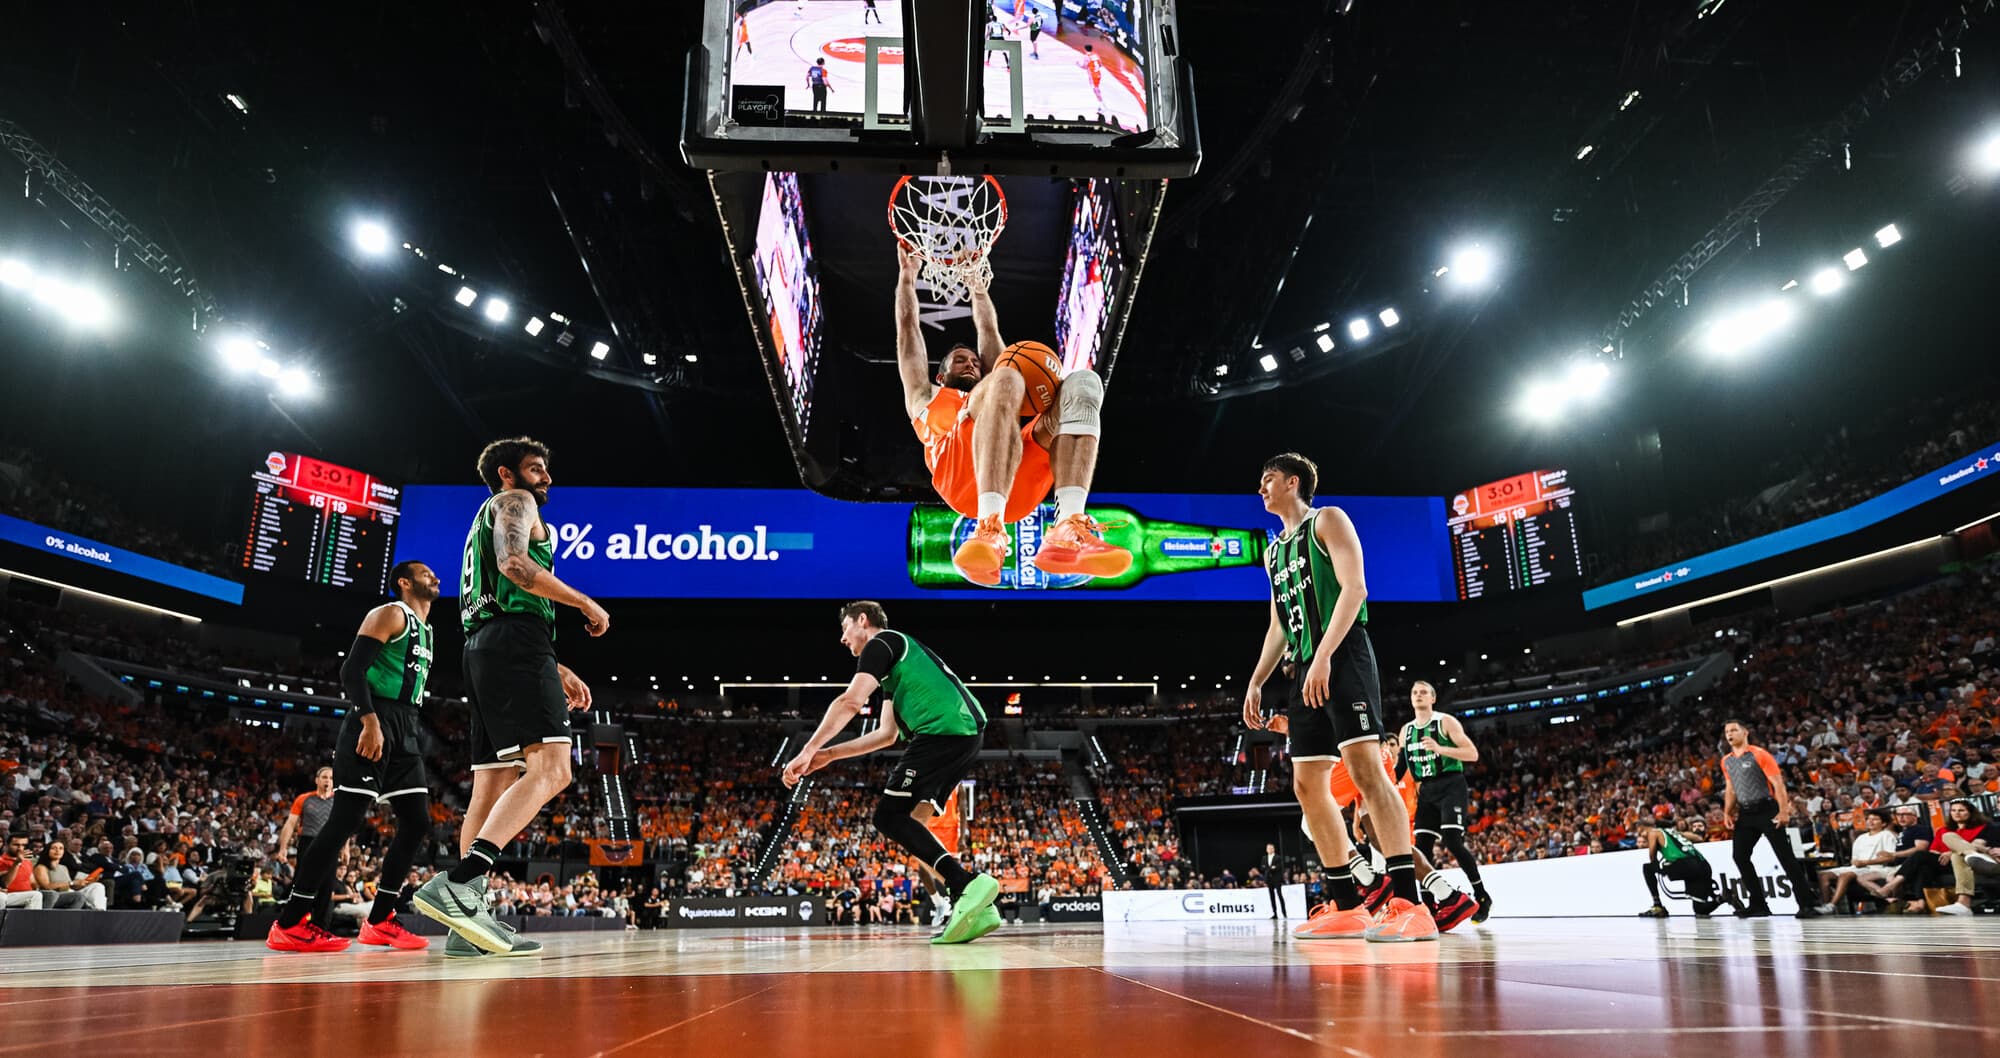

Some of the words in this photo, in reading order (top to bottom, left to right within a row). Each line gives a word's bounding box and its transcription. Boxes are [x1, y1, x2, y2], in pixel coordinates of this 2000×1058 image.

[310, 463, 353, 486] 3:01
[1487, 481, 1524, 500] 3:01
[308, 494, 325, 508] 15
[332, 500, 348, 513] 19
[1492, 511, 1508, 525] 15
[1511, 507, 1527, 520] 19
[45, 535, 65, 550] 0%
[66, 542, 112, 564] alcohol.
[606, 524, 780, 561] alcohol.
[463, 546, 475, 595] 9
[1421, 764, 1433, 777] 12
[1052, 901, 1101, 912] endesa
